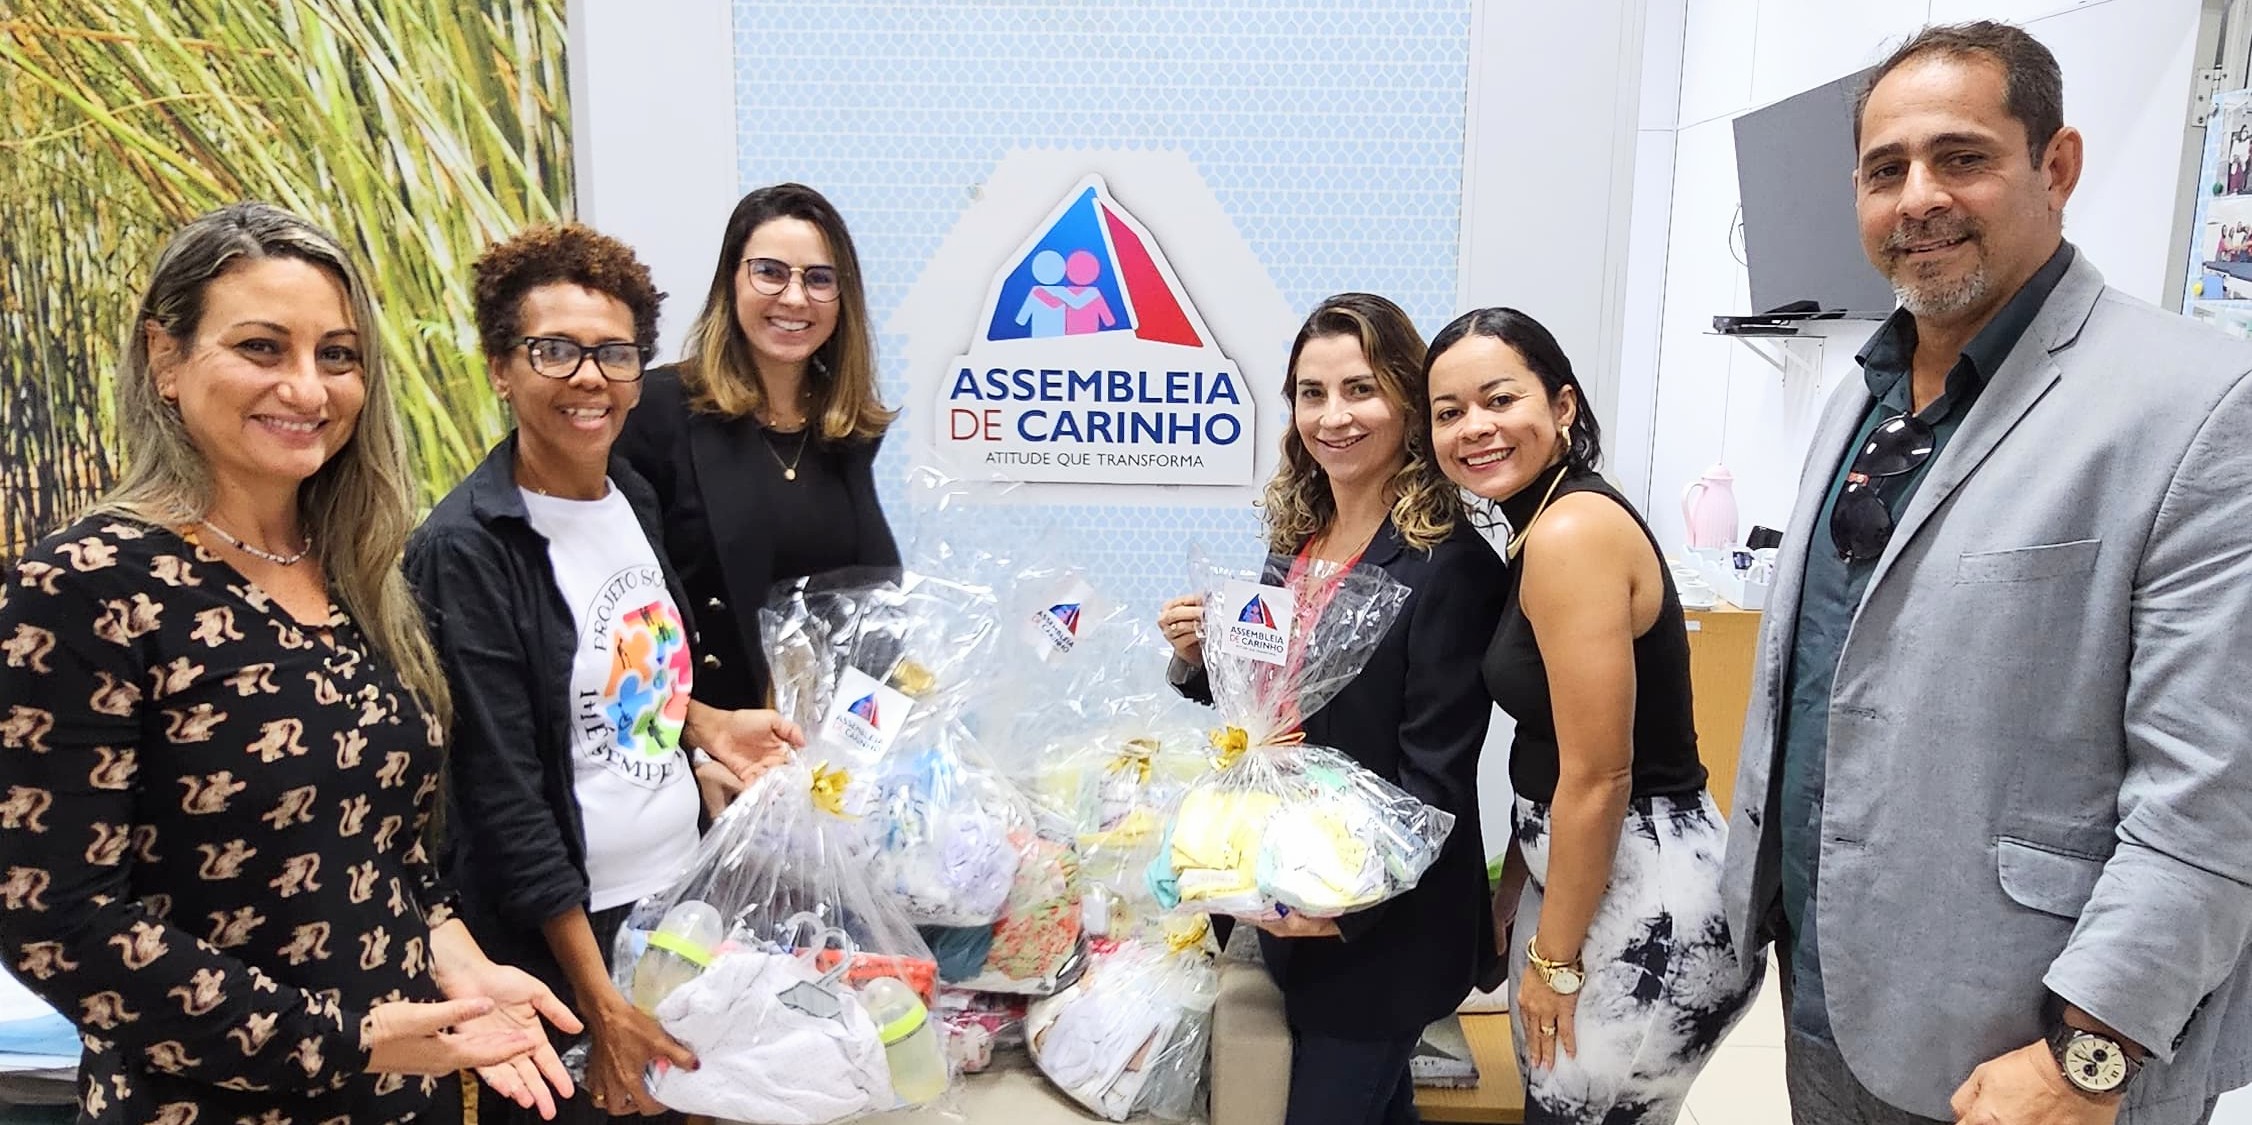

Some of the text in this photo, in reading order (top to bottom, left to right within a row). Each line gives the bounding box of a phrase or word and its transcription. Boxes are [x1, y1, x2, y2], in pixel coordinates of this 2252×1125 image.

[950, 368, 1240, 405] ASSEMBLEIA
[951, 408, 1241, 445] DE CARINHO
[985, 451, 1204, 468] ATITUDE QUE TRANSFORMA
[594, 571, 639, 652] PROJETO
[1230, 626, 1284, 645] ASSEMBLEIA
[1241, 637, 1284, 653] CARINHO
